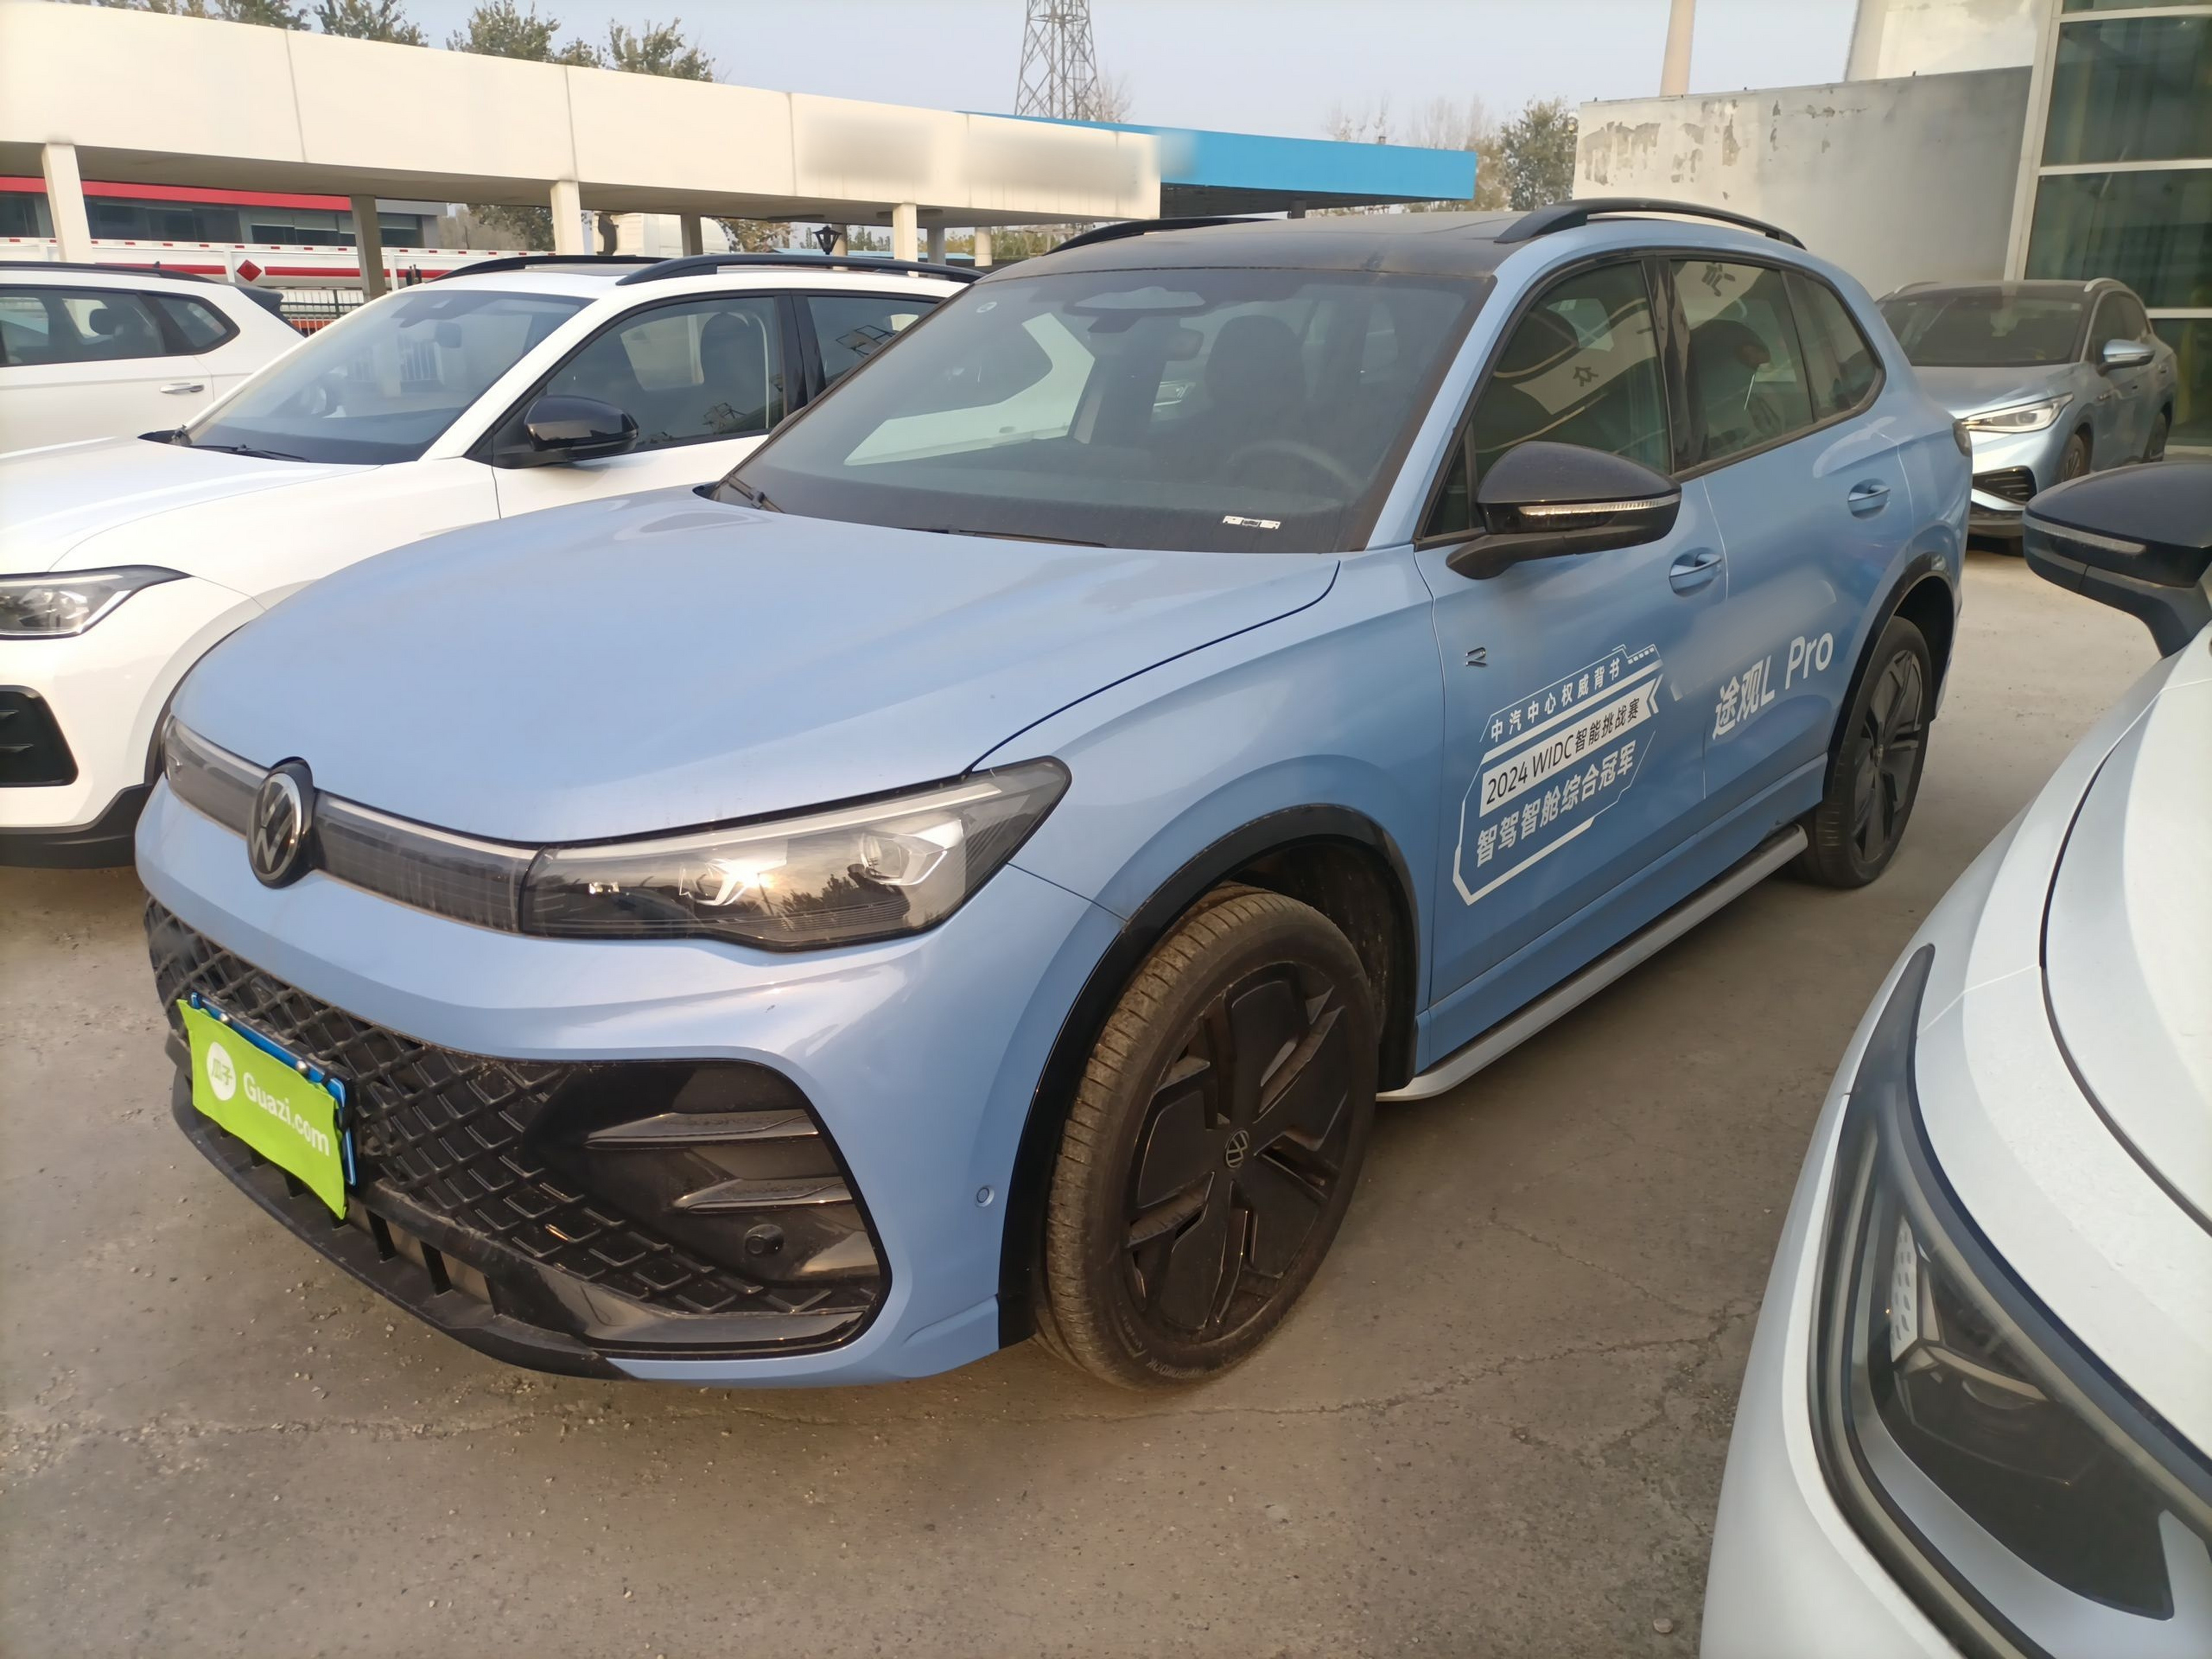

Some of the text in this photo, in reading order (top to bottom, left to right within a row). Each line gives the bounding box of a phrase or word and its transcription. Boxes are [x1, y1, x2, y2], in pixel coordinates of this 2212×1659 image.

[1491, 657, 1620, 743] 中汽中心权威背书
[1712, 632, 1834, 740] 途观L Pro
[1476, 740, 1637, 868] 智驾智舱综合冠军
[1486, 761, 1528, 805] 2024
[243, 1071, 330, 1157] Guazi.com
